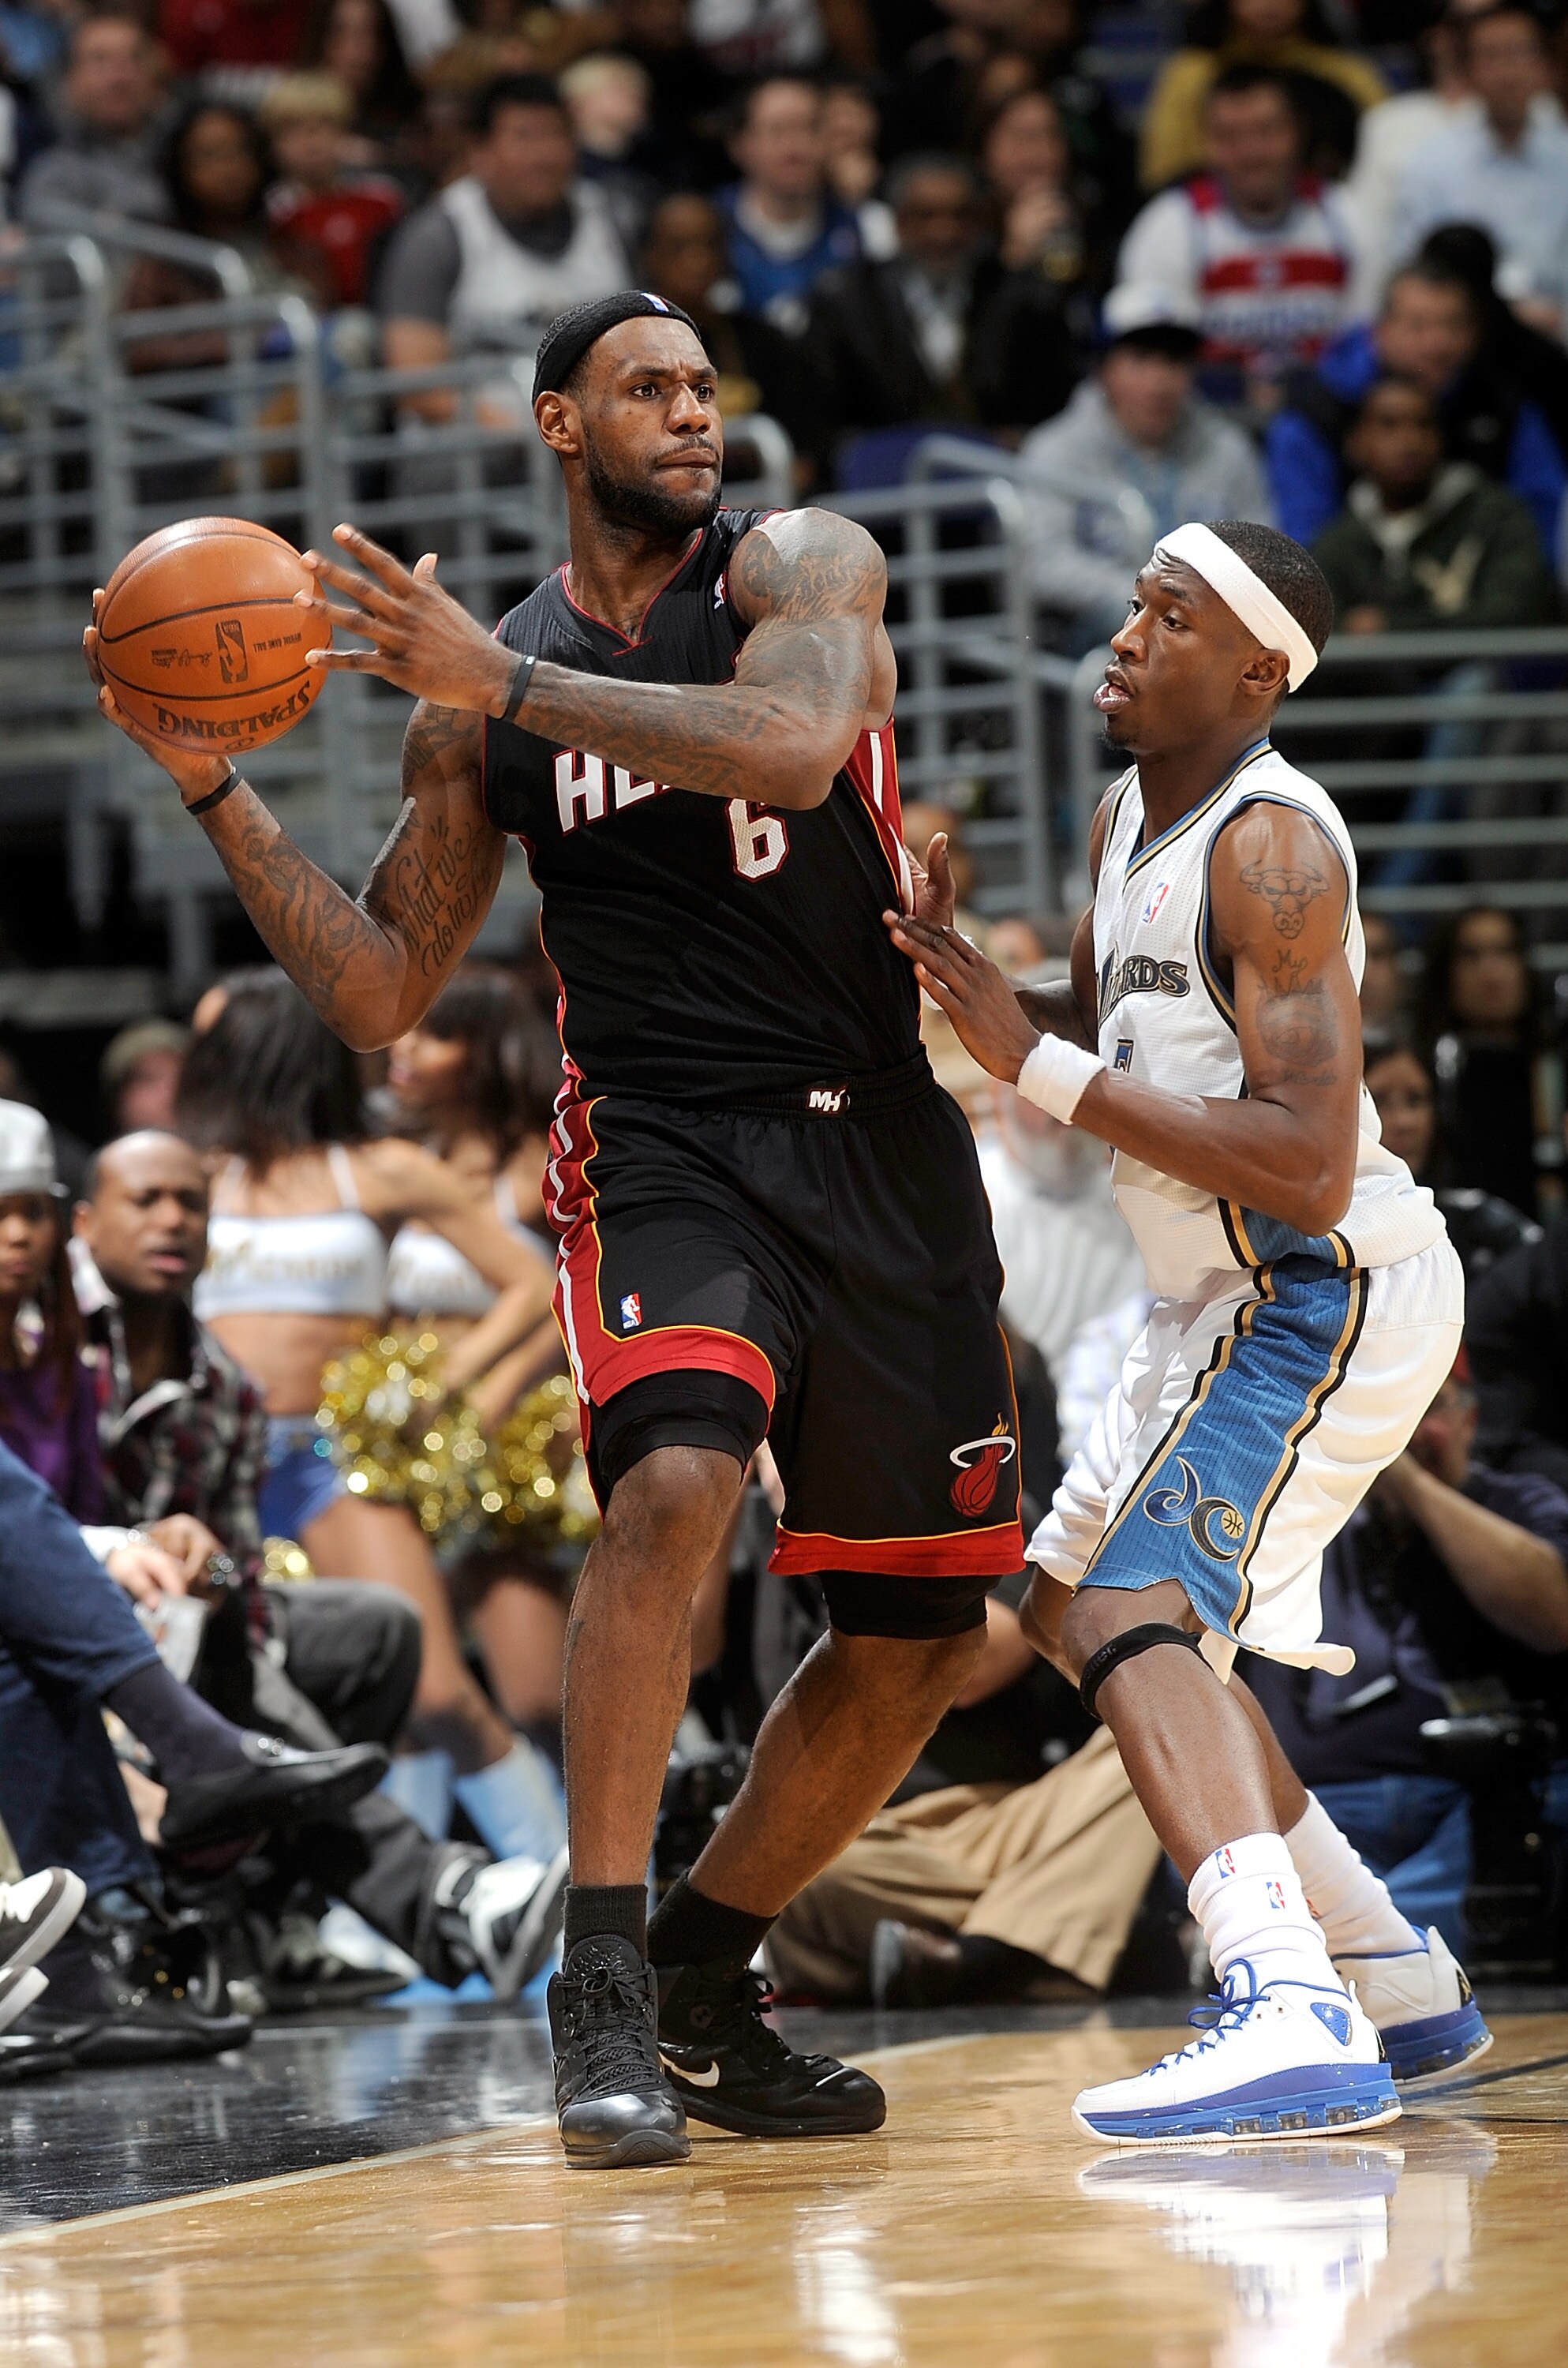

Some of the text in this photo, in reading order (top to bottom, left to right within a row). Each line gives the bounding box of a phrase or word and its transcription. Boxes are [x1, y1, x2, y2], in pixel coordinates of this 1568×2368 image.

[253, 642, 268, 653] BALL
[155, 680, 310, 738] SPALDING
[553, 748, 671, 837] HE
[725, 797, 789, 882] 6
